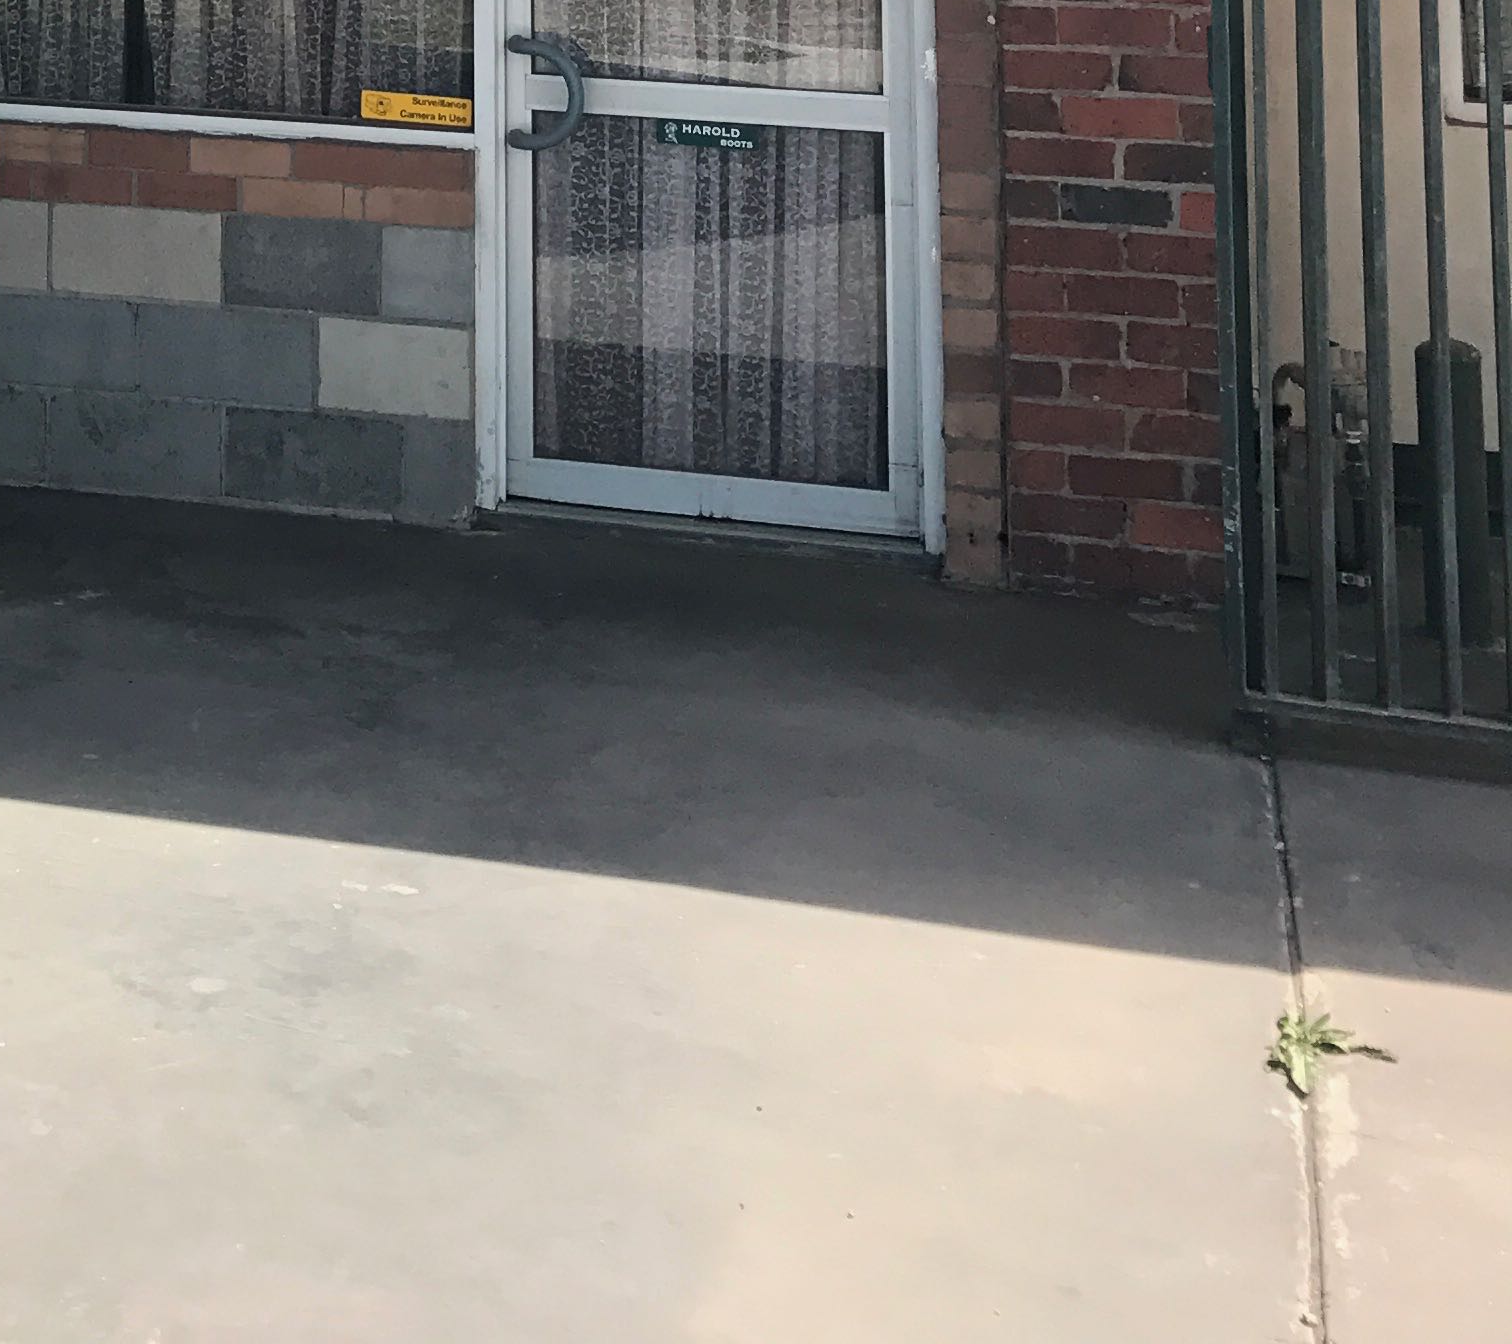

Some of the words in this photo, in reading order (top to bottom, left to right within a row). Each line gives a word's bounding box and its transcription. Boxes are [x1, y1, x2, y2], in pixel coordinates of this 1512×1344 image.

[412, 97, 467, 110] Surveillance
[400, 109, 435, 121] Camera
[438, 113, 447, 122] In
[449, 114, 467, 123] Use
[682, 124, 740, 138] HAROLD
[720, 138, 753, 149] BOOTS
